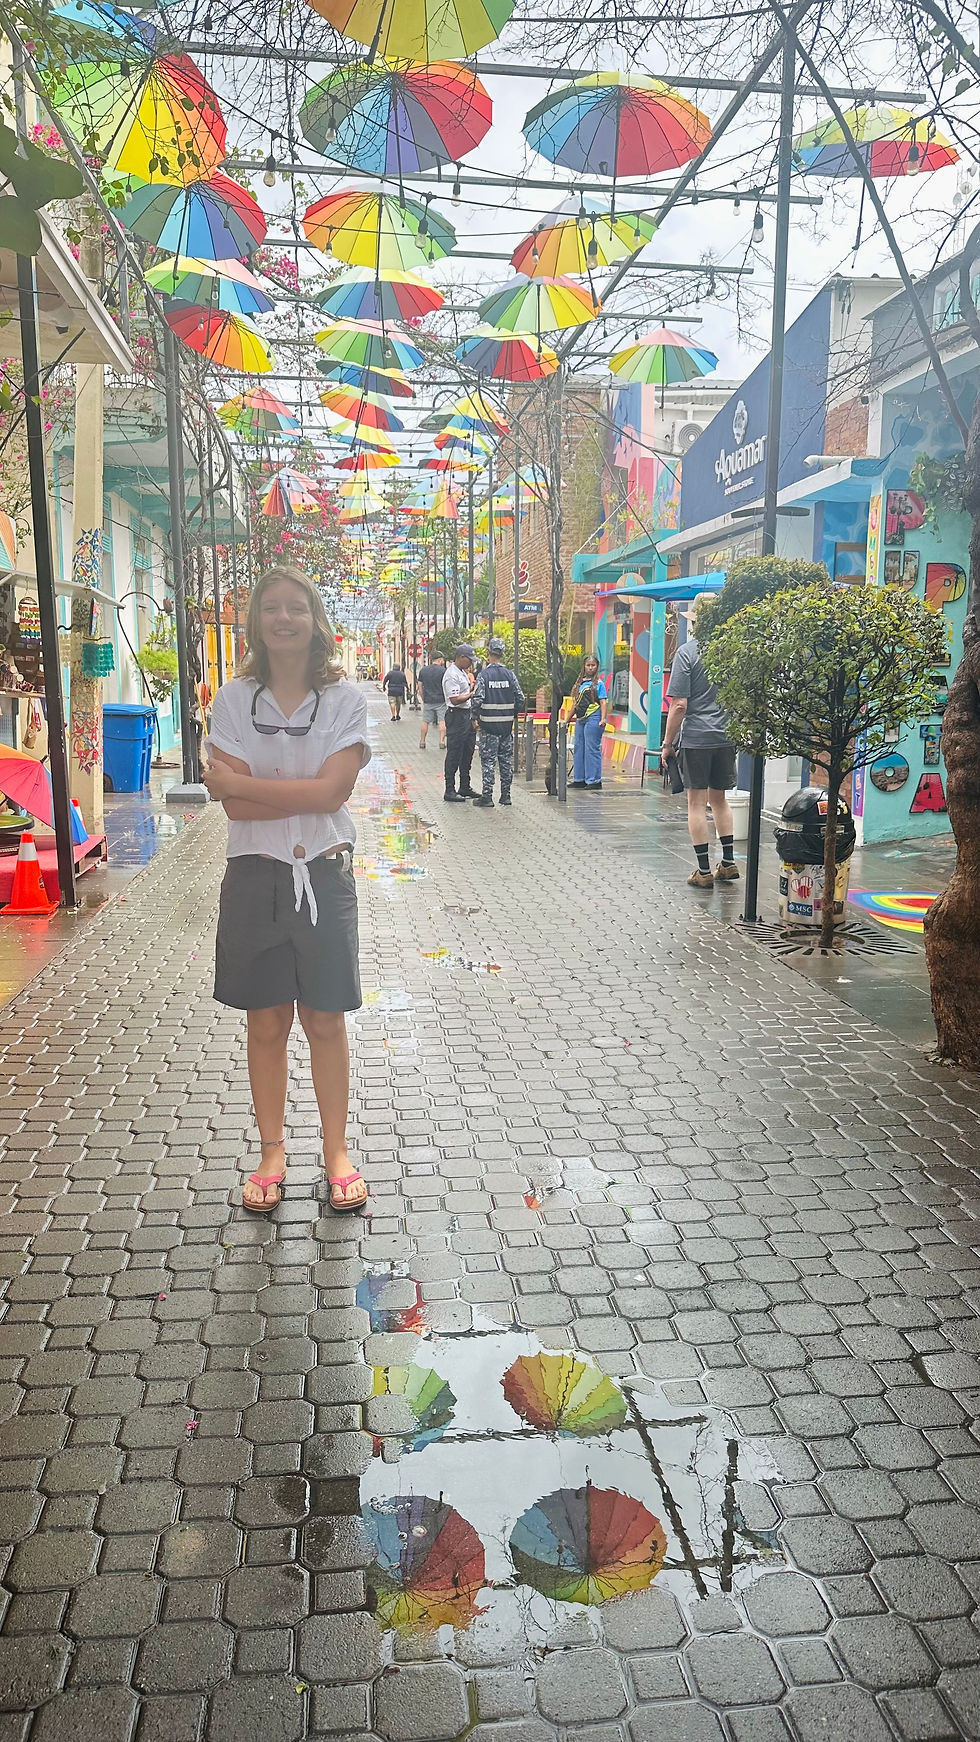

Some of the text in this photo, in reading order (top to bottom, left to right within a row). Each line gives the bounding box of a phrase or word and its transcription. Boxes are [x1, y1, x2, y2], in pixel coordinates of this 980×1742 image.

[715, 435, 768, 486] Aquamar
[523, 604, 538, 612] ATM
[795, 905, 812, 913] MSC
